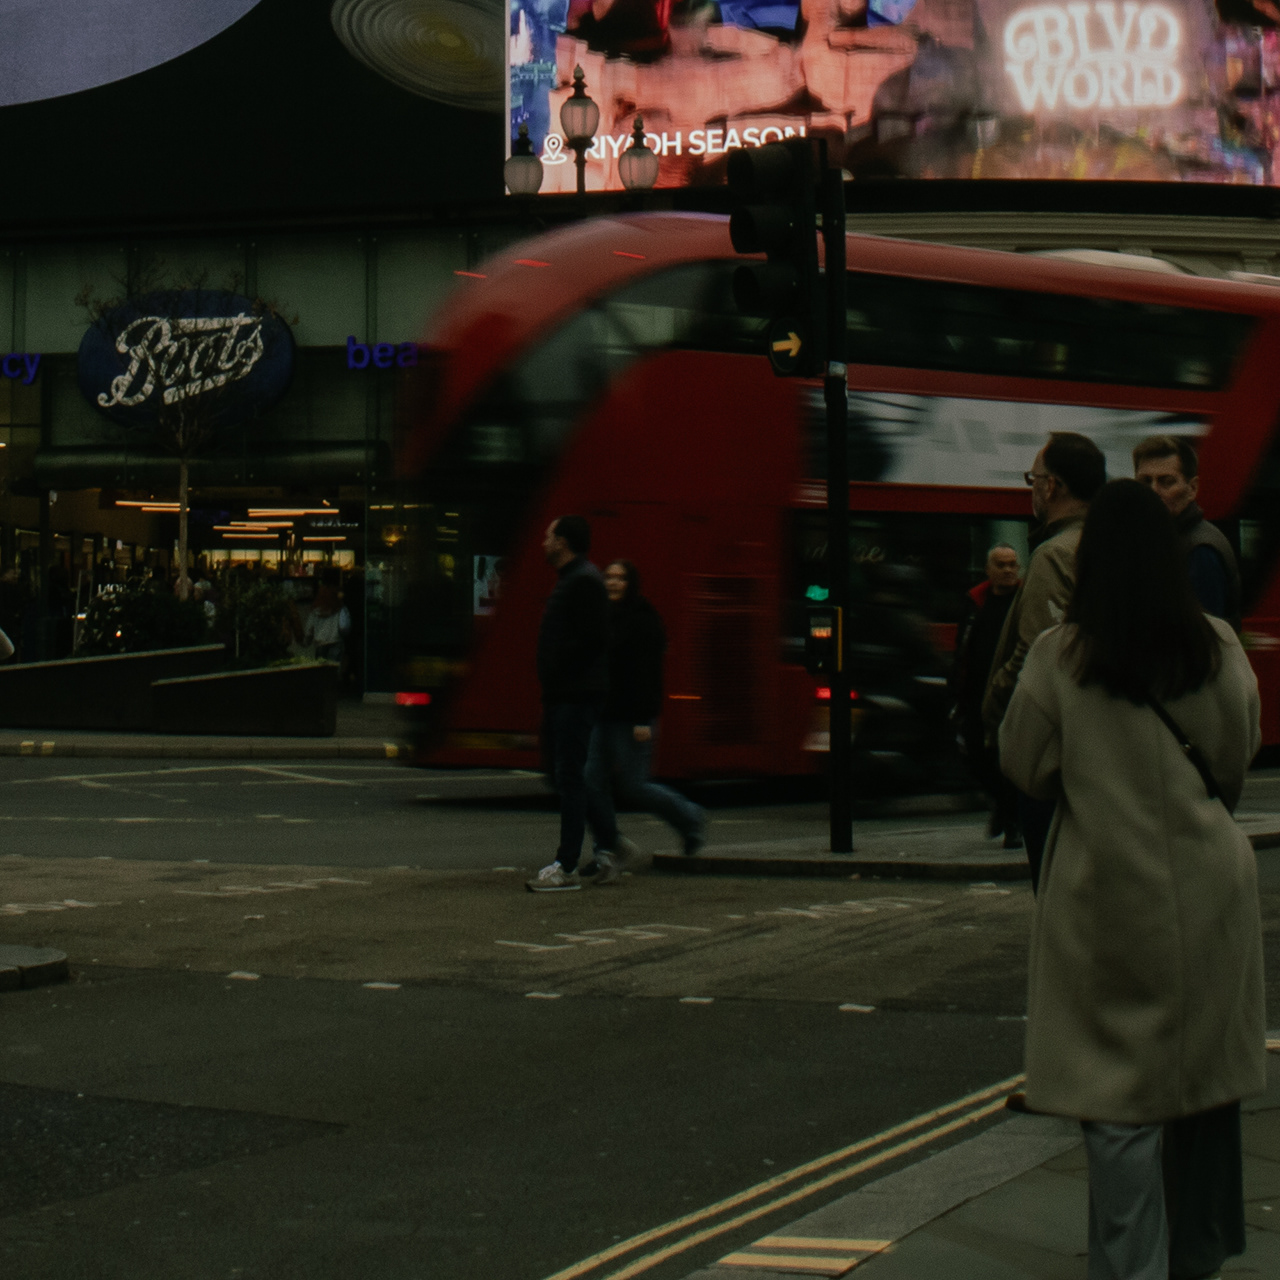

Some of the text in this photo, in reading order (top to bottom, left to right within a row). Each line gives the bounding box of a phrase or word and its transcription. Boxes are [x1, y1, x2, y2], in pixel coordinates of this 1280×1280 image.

[1004, 0, 1180, 62] BLVD
[1004, 61, 1183, 113] WORLD
[96, 311, 265, 408] Boots
[347, 335, 421, 369] bea
